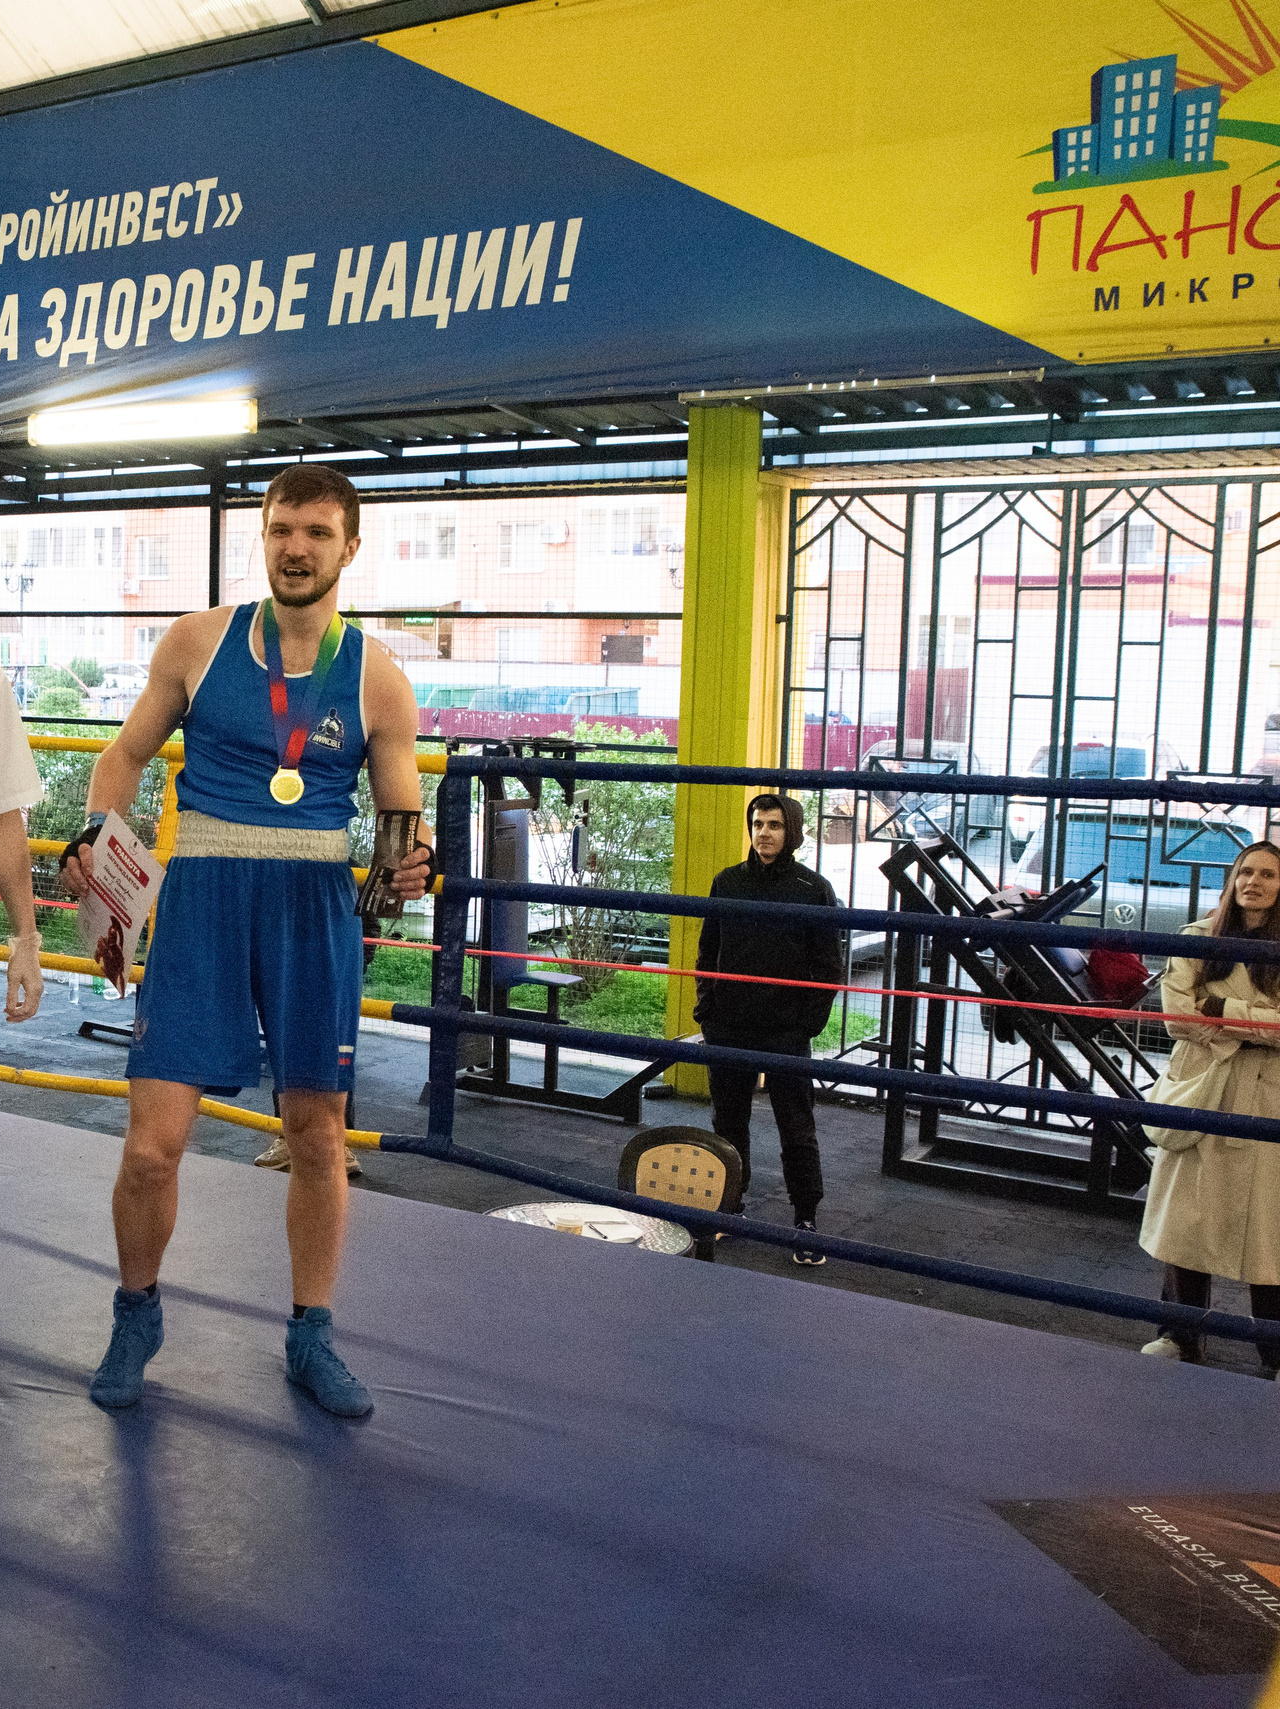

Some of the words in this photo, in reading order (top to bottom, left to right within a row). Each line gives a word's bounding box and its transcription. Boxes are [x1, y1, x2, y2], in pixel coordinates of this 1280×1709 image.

[34, 253, 317, 369] ЗДОРОВЬЕ
[327, 217, 584, 330] НАЦИИ!
[114, 844, 140, 877] ГРАМОТА
[1128, 1506, 1226, 1568] EURASIA
[1222, 1574, 1280, 1617] BUIL
